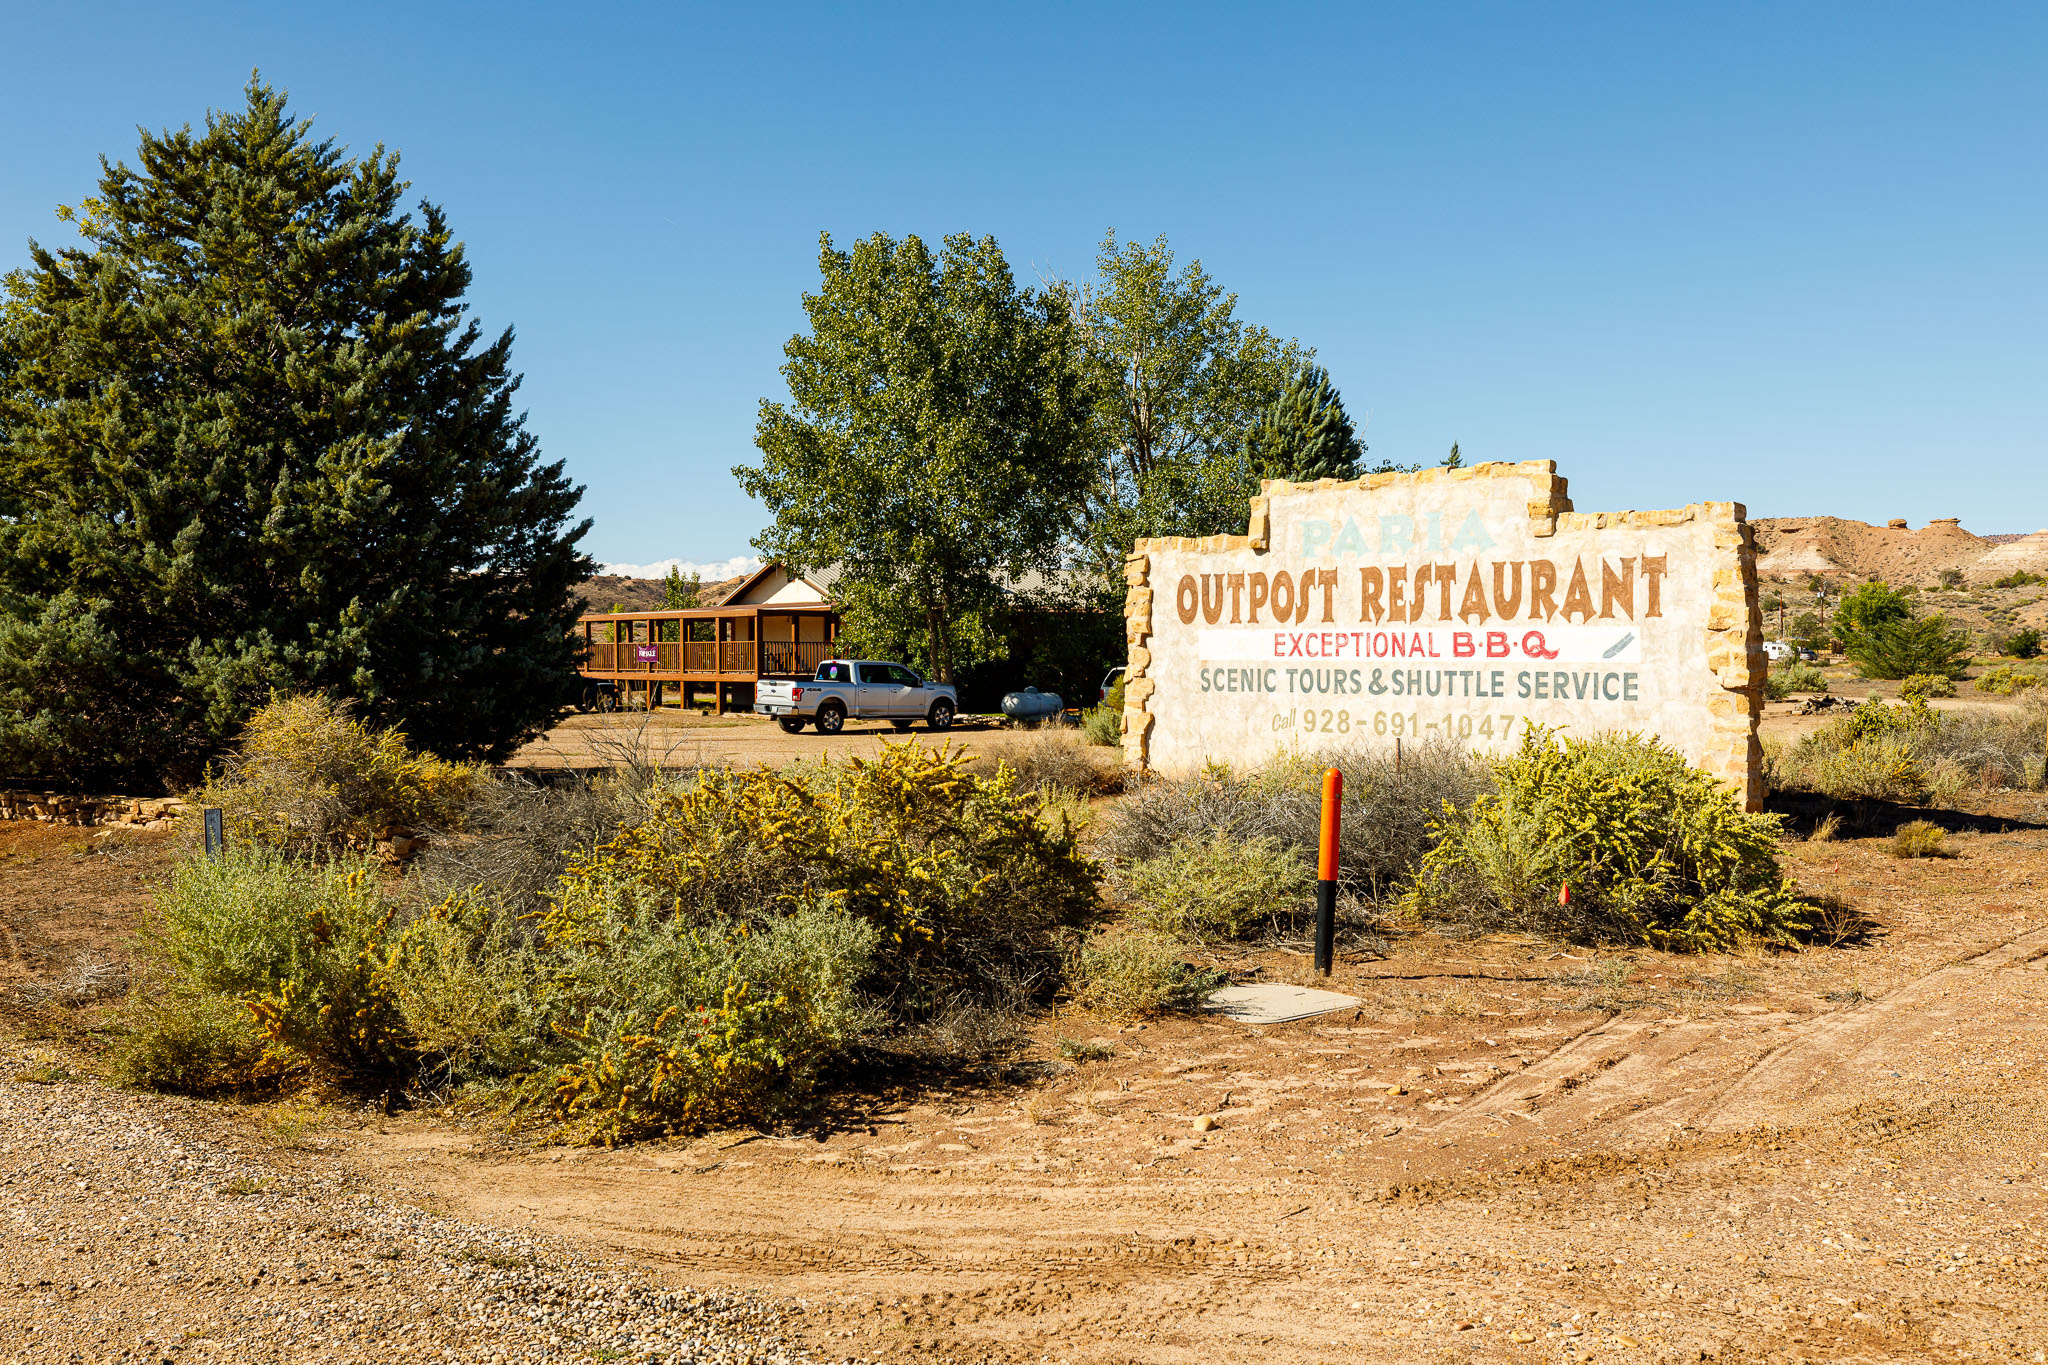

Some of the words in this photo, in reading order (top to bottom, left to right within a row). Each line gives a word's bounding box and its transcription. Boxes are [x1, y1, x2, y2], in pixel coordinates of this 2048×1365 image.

[1300, 507, 1497, 558] PARIA
[1177, 566, 1338, 626] OUTPOST
[1359, 552, 1667, 626] RESTAURANT
[1274, 631, 1441, 658] EXCEPTIONAL
[1200, 667, 1277, 693] SCENIC
[1286, 668, 1362, 695] TOURS
[1517, 670, 1639, 702] SERVICE
[1271, 707, 1297, 732] Call
